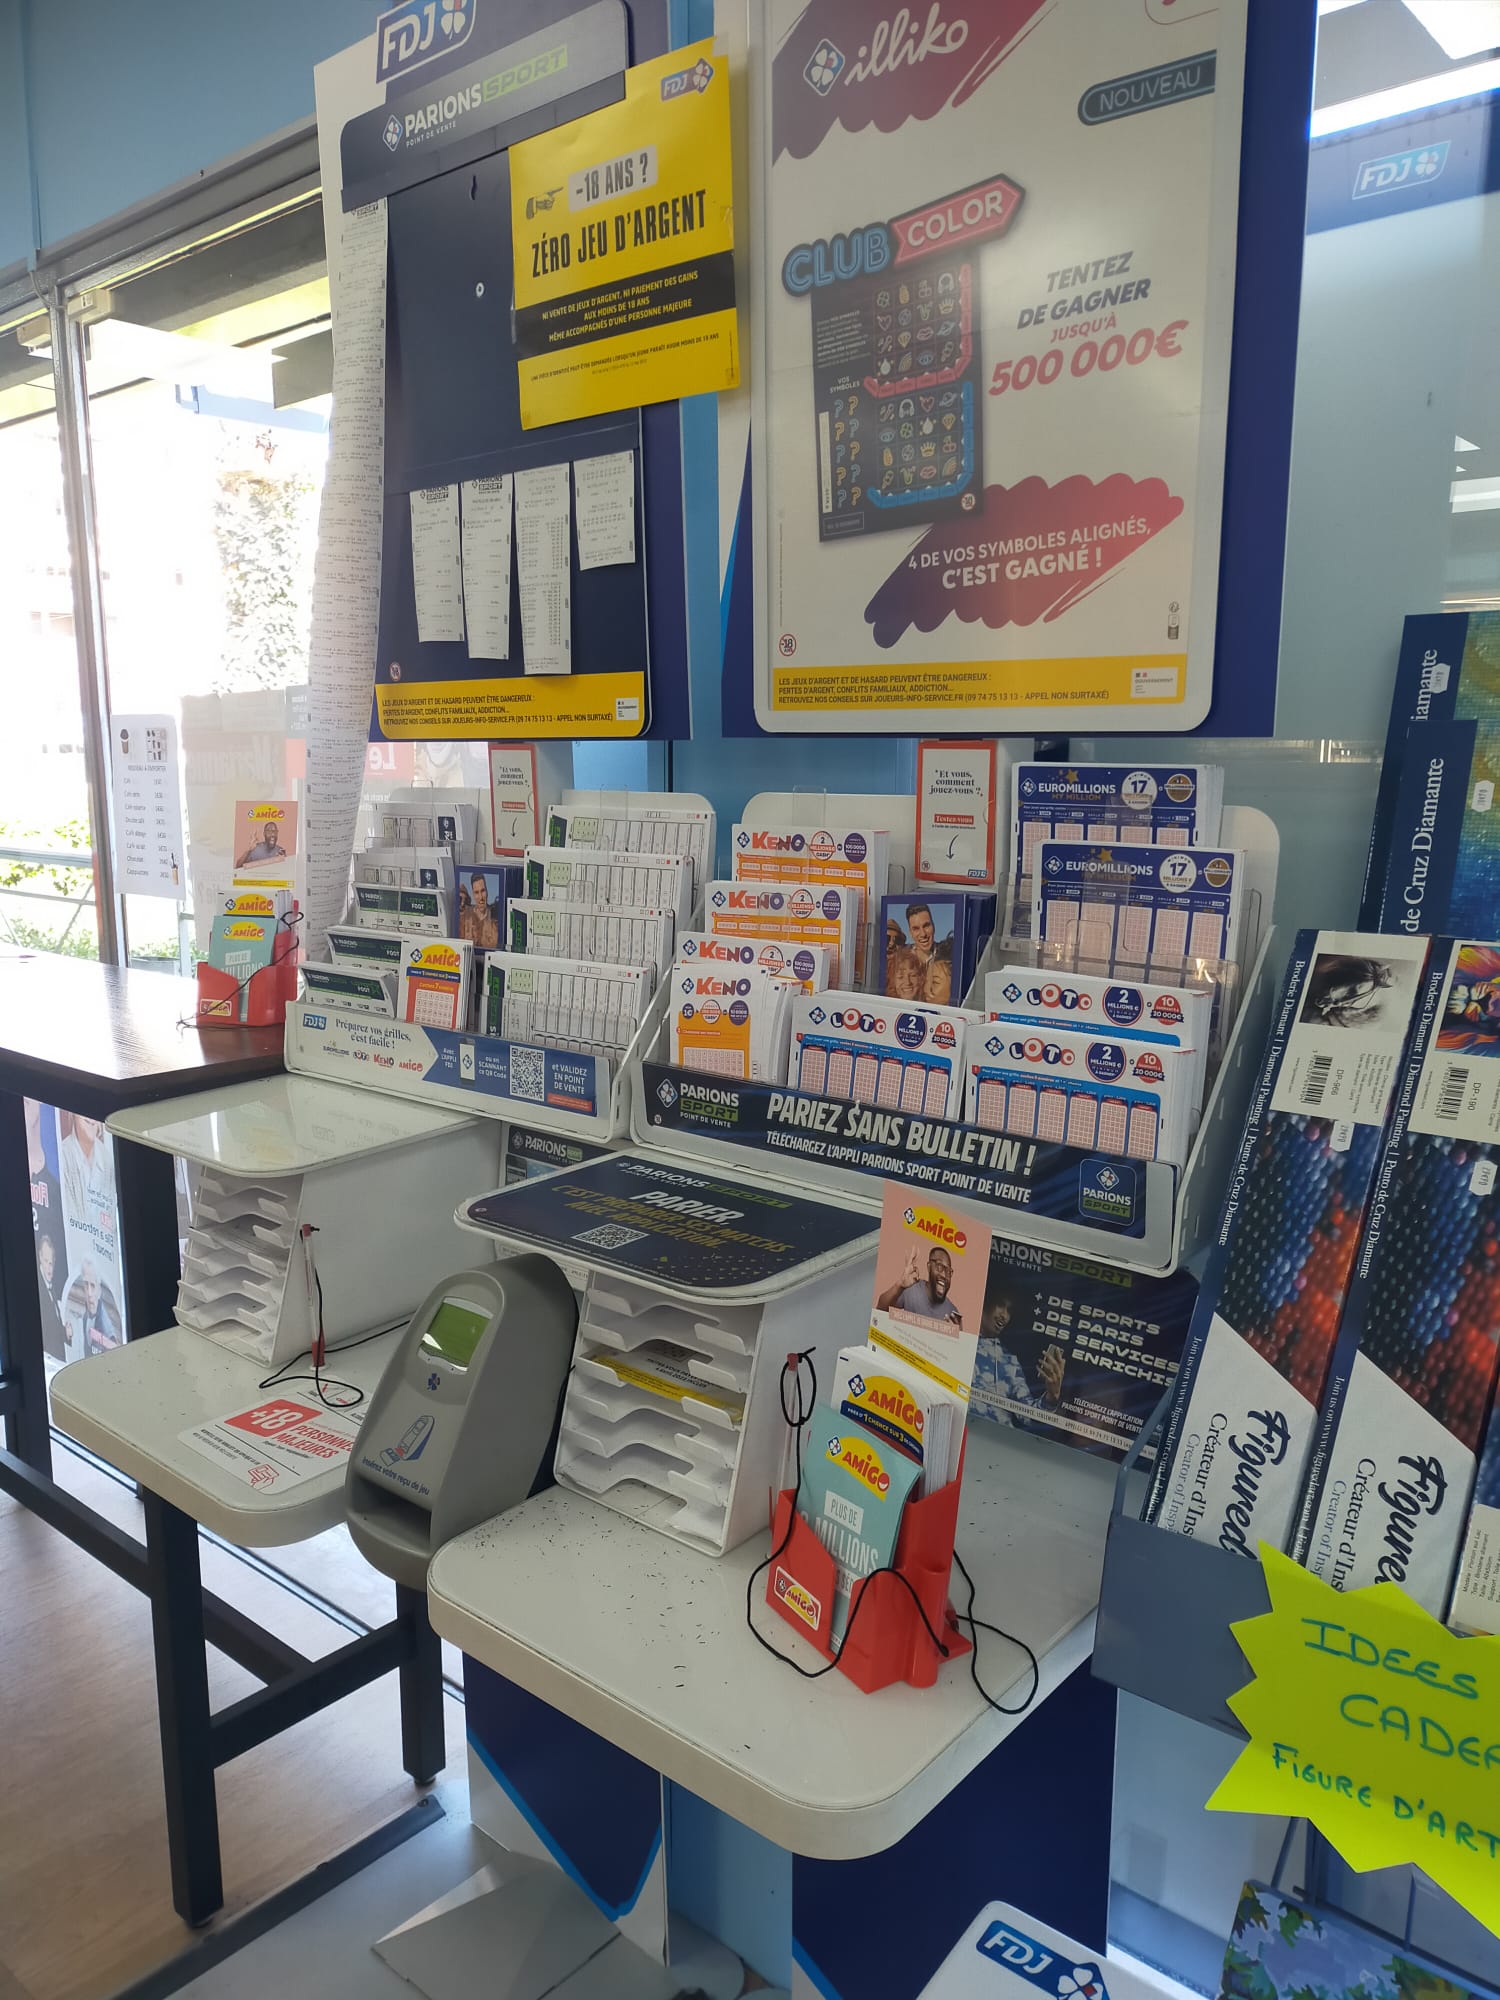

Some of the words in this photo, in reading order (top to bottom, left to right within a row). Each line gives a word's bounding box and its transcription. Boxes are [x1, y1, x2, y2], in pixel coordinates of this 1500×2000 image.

[382, 1, 435, 70] FDJ
[844, 2, 968, 86] illiko
[404, 83, 483, 137] PARIONS
[484, 47, 567, 99] SPORT
[663, 77, 688, 98] FDJ
[1099, 66, 1200, 113] NOUVEAU
[406, 133, 425, 147] POINT
[435, 121, 456, 137] VENTE
[605, 162, 634, 196] ANS
[639, 152, 649, 184] ?
[1361, 158, 1412, 190] FDJ
[907, 189, 1004, 248] COLOR
[532, 229, 571, 279] ZÉRO
[577, 224, 608, 264] JEU
[615, 189, 706, 253] D'ARGENT
[787, 227, 890, 294] CLUB
[1047, 251, 1133, 293] TENTEZ
[550, 307, 567, 318] VENTE
[631, 280, 663, 297] PAIEMENT
[678, 270, 699, 284] GAINS
[1017, 305, 1046, 330] DE
[1050, 278, 1151, 321] GAGNER
[598, 305, 617, 317] MOINS
[628, 307, 662, 323] PERSONNE
[662, 298, 692, 314] MAJEURE
[1050, 313, 1117, 344] JUSQU'À
[829, 381, 860, 394] SYMBOLES
[908, 553, 917, 570] 4
[921, 550, 940, 568] DE
[944, 544, 976, 564] VOS
[978, 533, 1068, 559] SYMBOLES
[1070, 517, 1152, 546] ALIGNÉS,
[942, 562, 1000, 590] C'EST
[1005, 544, 1090, 580] GAGNÉ
[779, 687, 803, 695] PERTES
[836, 686, 869, 694] CONFLITS
[808, 677, 839, 685] D'ARGENT
[860, 676, 888, 684] HASARD
[889, 674, 922, 683] PEUVENT
[923, 672, 940, 682] ÊTRE
[943, 674, 986, 682] DANGEREUX
[500, 695, 532, 703] DANGEREUX
[779, 696, 814, 704] RETROUVEZ
[829, 695, 859, 703] CONSEILS
[1025, 691, 1049, 700] APPEL
[1051, 691, 1068, 700] NON
[935, 778, 975, 787] comment
[1038, 782, 1116, 795] EUROMILLIONS
[1130, 779, 1148, 794] 17
[1411, 757, 1444, 853] Diamante
[1065, 860, 1154, 877] EUROMILLIONS
[1169, 862, 1188, 876] 17
[1403, 855, 1431, 898] Cruz
[1400, 908, 1421, 932] de
[1287, 960, 1306, 997] Broderie
[1424, 972, 1443, 1011] Broderie
[1027, 983, 1093, 1011] LOTO
[335, 1018, 369, 1033] Préparez
[830, 1008, 887, 1034] LOTO
[1276, 998, 1296, 1037] Diamant
[1413, 1011, 1433, 1053] Diamant
[368, 1035, 391, 1048] facile
[1009, 1037, 1076, 1066] LOTO
[478, 1061, 507, 1072] SCANNANT
[560, 1064, 587, 1077] VALIDEZ
[564, 1073, 585, 1086] POINT
[1261, 1045, 1282, 1087] Diamond
[563, 1083, 585, 1095] VENTE
[680, 1082, 739, 1107] PARIONS
[1400, 1063, 1421, 1107] Diamond
[680, 1111, 698, 1122] POINT
[710, 1118, 731, 1129] VENTE
[681, 1100, 738, 1120] SPORT
[1249, 1088, 1271, 1127] Painting
[767, 1092, 842, 1133] PARIEZ
[844, 1105, 905, 1147] SANS
[905, 1121, 1024, 1175] BULLETIN
[1023, 1145, 1036, 1176] !
[1388, 1109, 1411, 1149] Painting
[525, 1135, 567, 1157] PARIONS
[1239, 1135, 1257, 1163] Punto
[627, 1164, 711, 1189] PARIONS
[767, 1130, 825, 1157] TÉLÉCHARGEZ
[827, 1143, 859, 1164] L'APPLI
[861, 1151, 904, 1176] PARIONS
[904, 1162, 940, 1184] SPORT
[941, 1169, 976, 1191] POINT
[977, 1177, 993, 1195] DE
[993, 1182, 1031, 1204] VENTE
[1381, 1159, 1397, 1189] Punto
[1083, 1187, 1131, 1206] PARIONS
[1229, 1176, 1245, 1201] Cruz
[564, 1200, 616, 1217] AVEC
[629, 1190, 745, 1225] PARIER,
[1084, 1199, 1130, 1215] SPORT
[1370, 1203, 1386, 1229] Cruz
[1218, 1201, 1239, 1246] Diamante
[712, 1225, 796, 1253] MATCHS
[991, 1236, 1052, 1267] ARIONS
[1053, 1254, 1131, 1286] SPORT
[1016, 1259, 1042, 1273] VENTE
[1359, 1230, 1381, 1279] Diamante
[1046, 1310, 1073, 1326] DE
[1077, 1320, 1144, 1346] PARIS
[1048, 1295, 1074, 1311] DE
[1079, 1304, 1161, 1336] SPORTS
[1032, 1322, 1070, 1341] DES
[1075, 1334, 1180, 1373] SERVICES
[1193, 1336, 1203, 1356] Join
[1335, 1375, 1345, 1397] Join
[250, 1408, 303, 1431] +18
[868, 1417, 889, 1432] CHANCE
[1061, 1401, 1084, 1415] PARIONS
[1084, 1408, 1101, 1421] SPORT
[272, 1432, 339, 1459] MAJEURES
[1178, 1433, 1201, 1482] Creator
[1194, 1412, 1228, 1487] Créateur
[830, 1498, 848, 1521] PLUS
[848, 1507, 858, 1527] DE
[1324, 1480, 1348, 1534] Creator
[1341, 1458, 1377, 1541] Créateur
[815, 1516, 879, 1575] MILLIONS
[1302, 1617, 1479, 1700] IDEES
[983, 1930, 1053, 1975] FDJ
